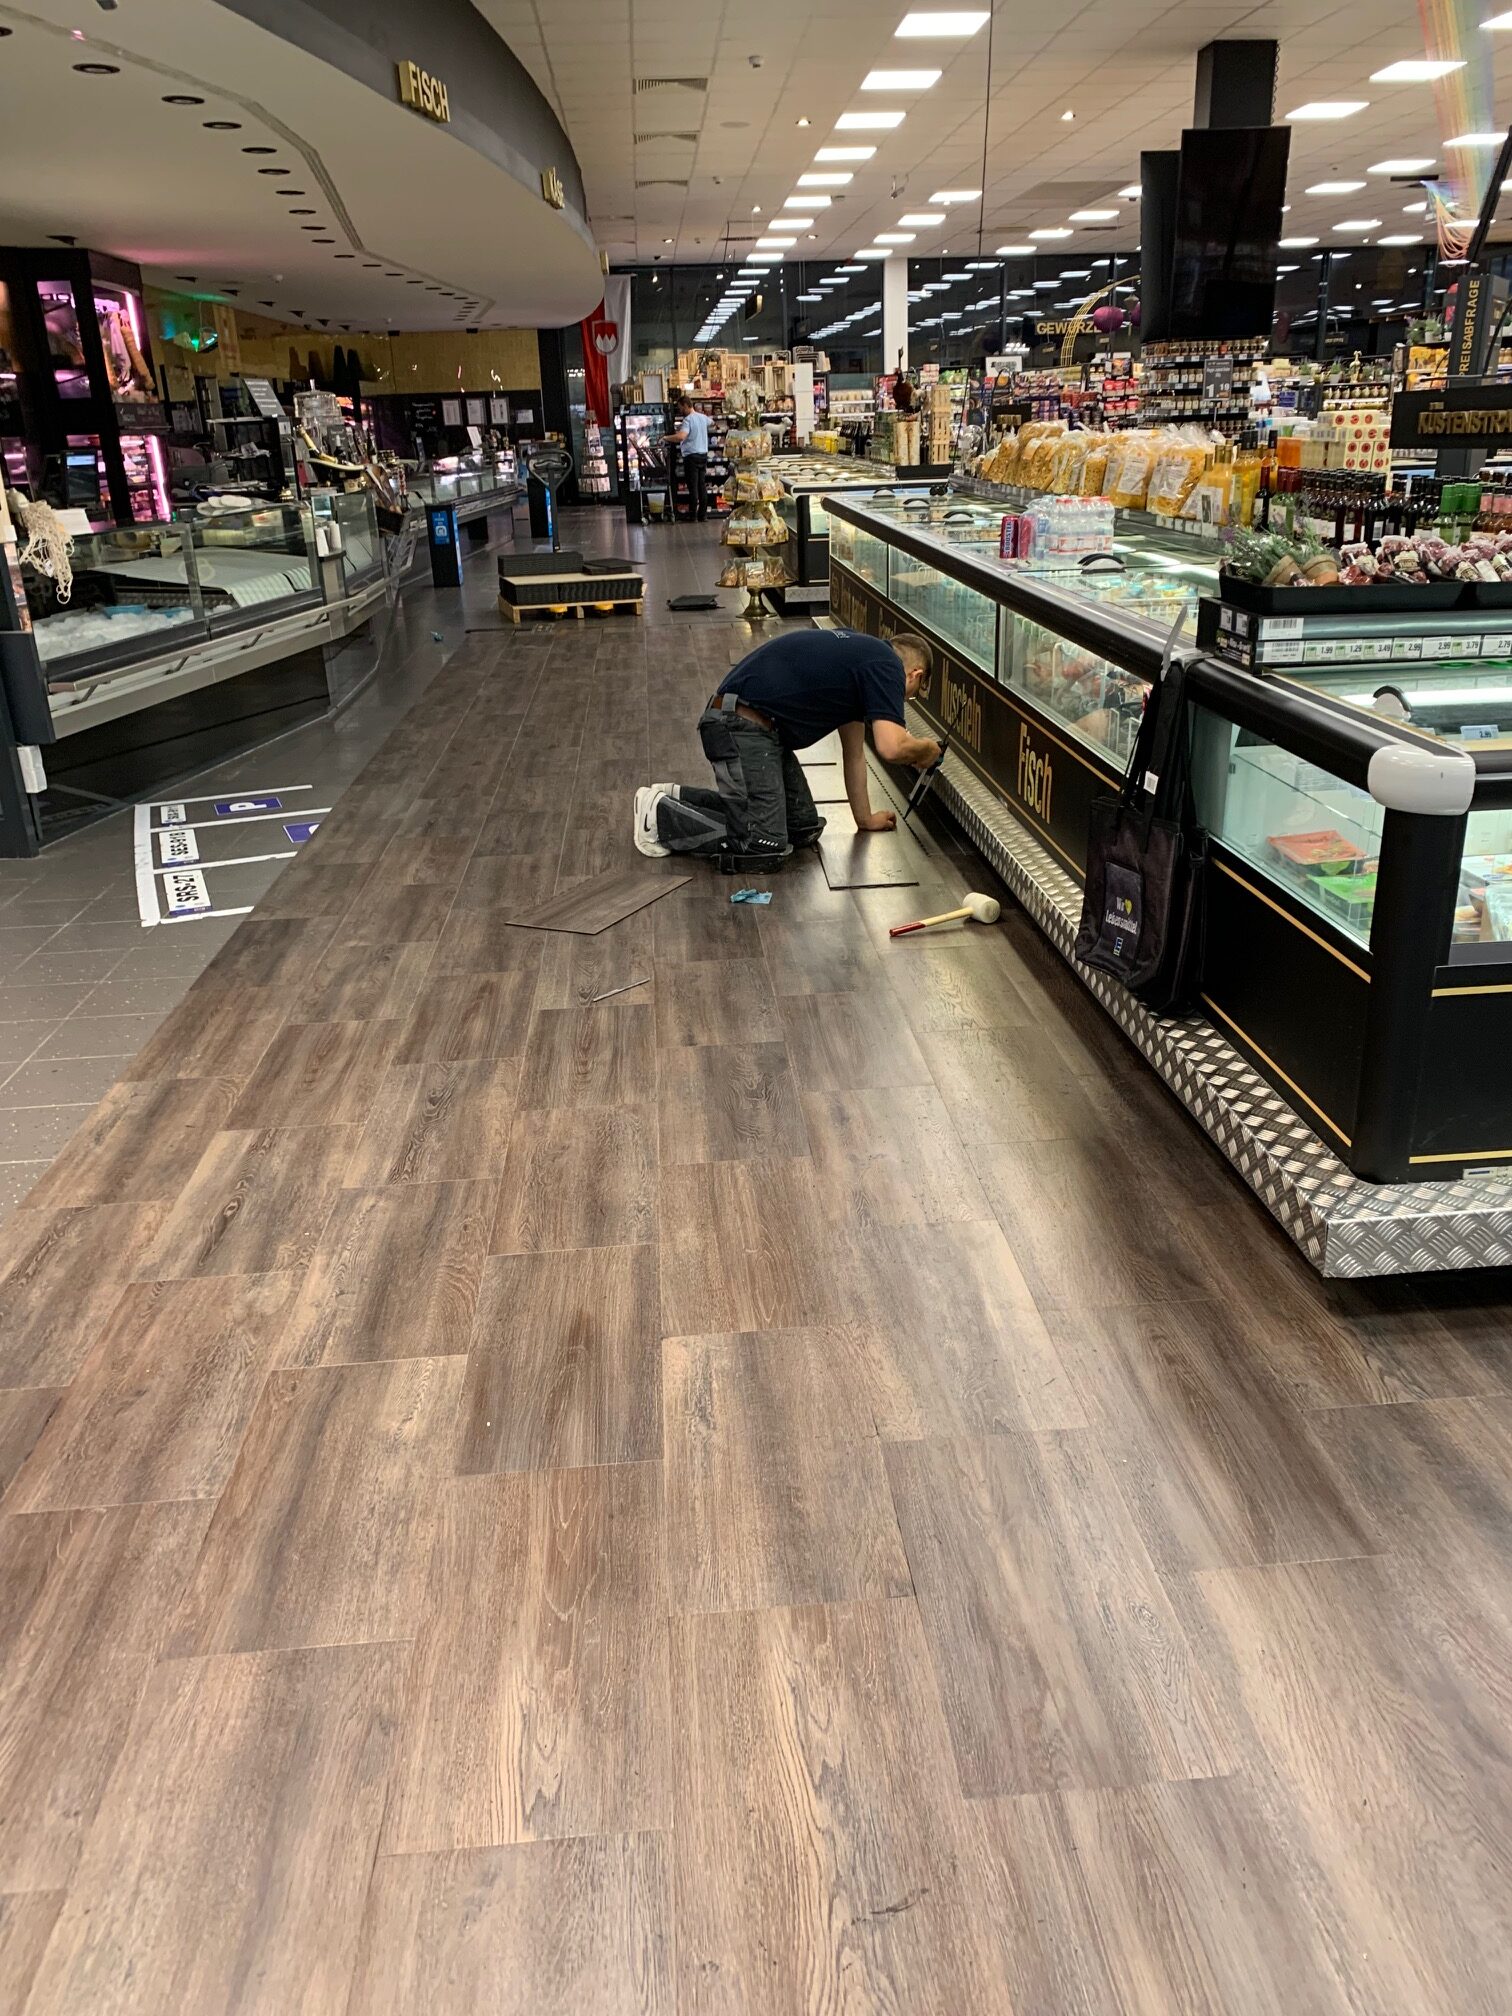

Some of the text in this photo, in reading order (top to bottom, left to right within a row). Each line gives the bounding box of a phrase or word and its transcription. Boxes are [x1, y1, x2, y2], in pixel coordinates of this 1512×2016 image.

[403, 60, 451, 122] FISCH
[1017, 721, 1053, 824] Fisch
[172, 873, 200, 903] SRS-27
